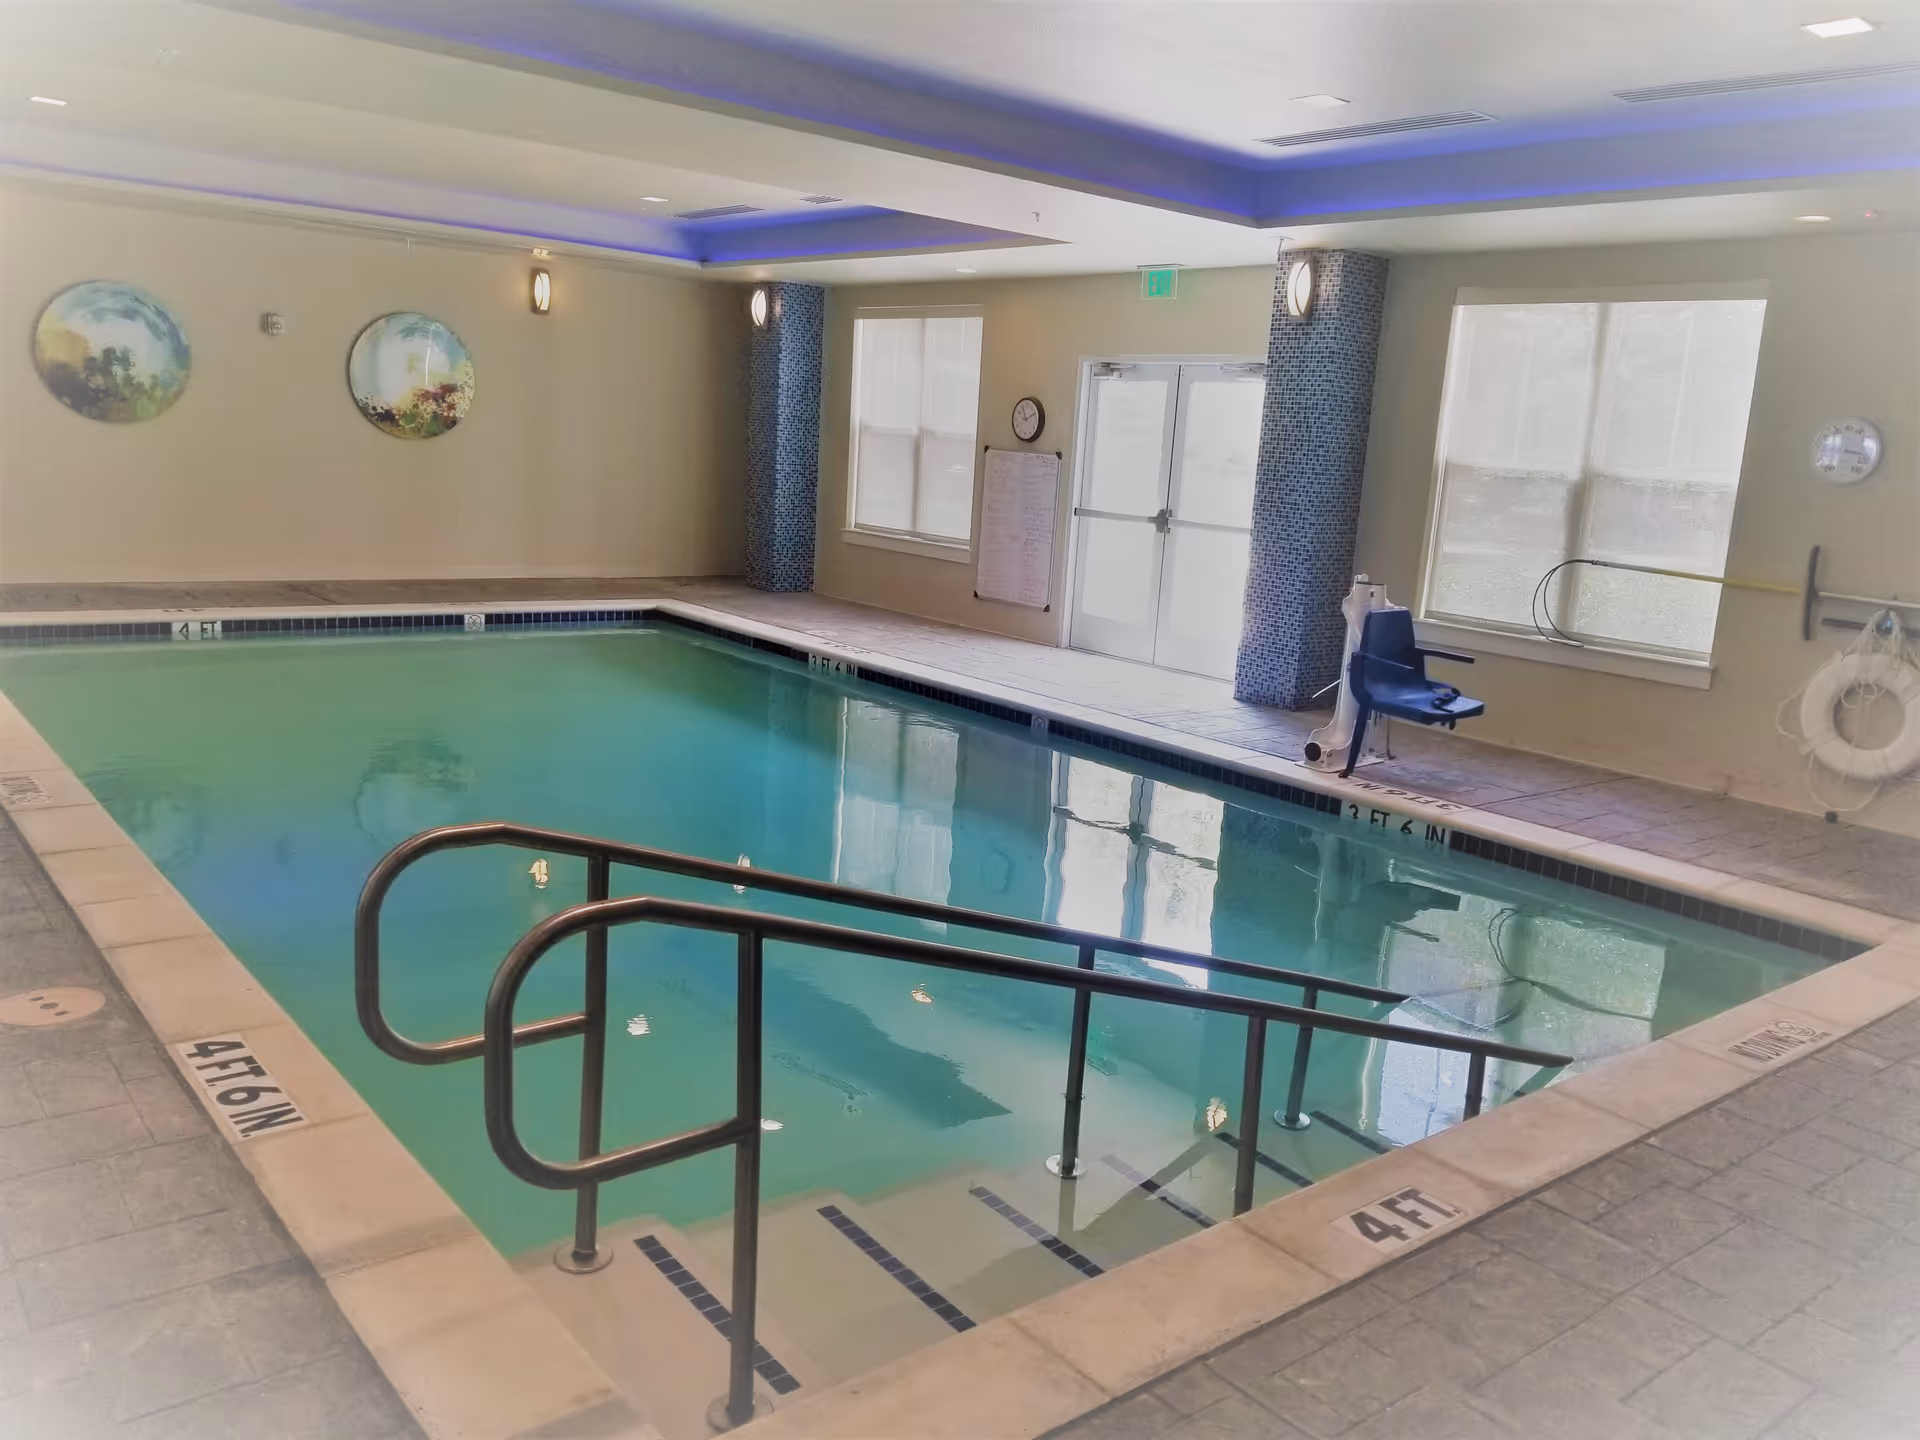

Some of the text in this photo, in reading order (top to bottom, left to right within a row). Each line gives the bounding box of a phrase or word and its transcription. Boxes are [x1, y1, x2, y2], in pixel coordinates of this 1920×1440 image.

[1148, 270, 1172, 296] EXIT
[200, 621, 218, 633] FT
[1369, 809, 1391, 828] FT
[1400, 819, 1413, 835] 6
[1424, 824, 1446, 845] IN
[185, 1041, 247, 1058] 4
[215, 1086, 283, 1106] 6
[1350, 1211, 1411, 1244] 4
